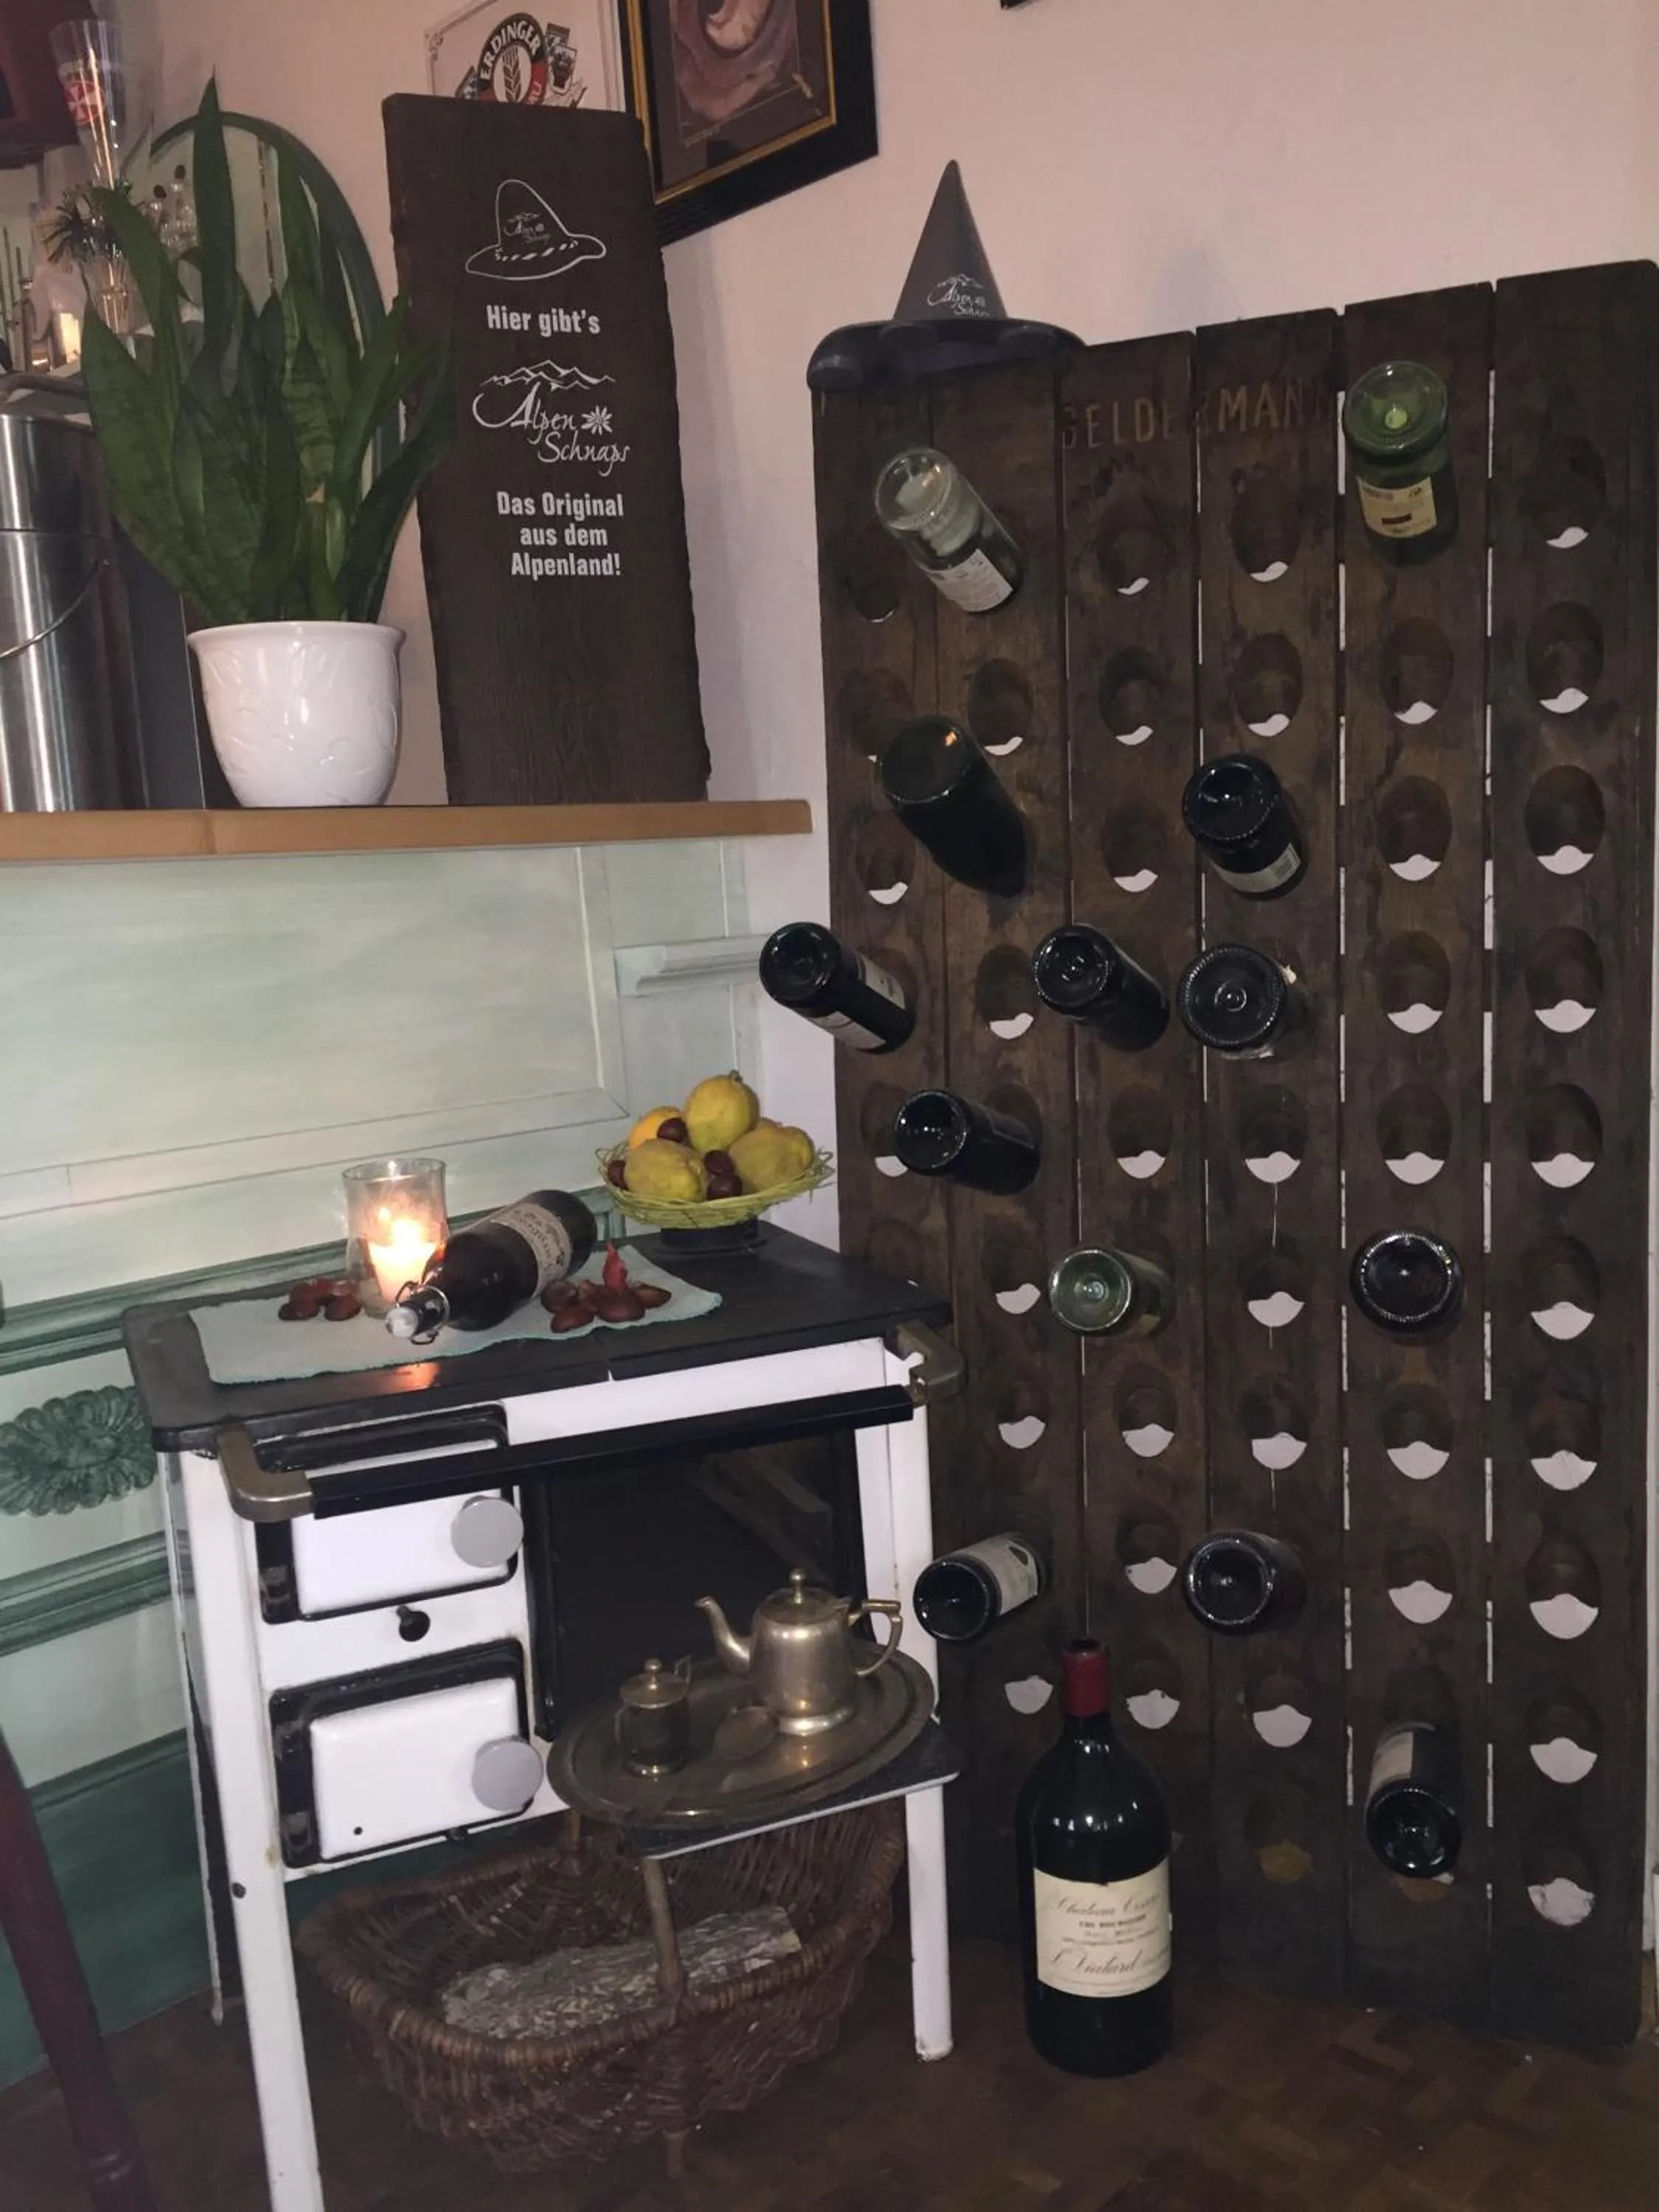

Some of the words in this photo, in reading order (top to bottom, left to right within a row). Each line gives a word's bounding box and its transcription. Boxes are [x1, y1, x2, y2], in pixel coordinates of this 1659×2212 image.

[480, 20, 542, 80] ERDINGER
[486, 305, 532, 331] Hier
[538, 307, 601, 338] gibt's
[472, 381, 578, 445] Alpen
[538, 430, 630, 477] Schnaps
[496, 491, 536, 516] Das
[542, 492, 624, 521] Original
[520, 527, 558, 546] aus
[564, 523, 608, 546] dem
[511, 552, 621, 581] Alpenland!
